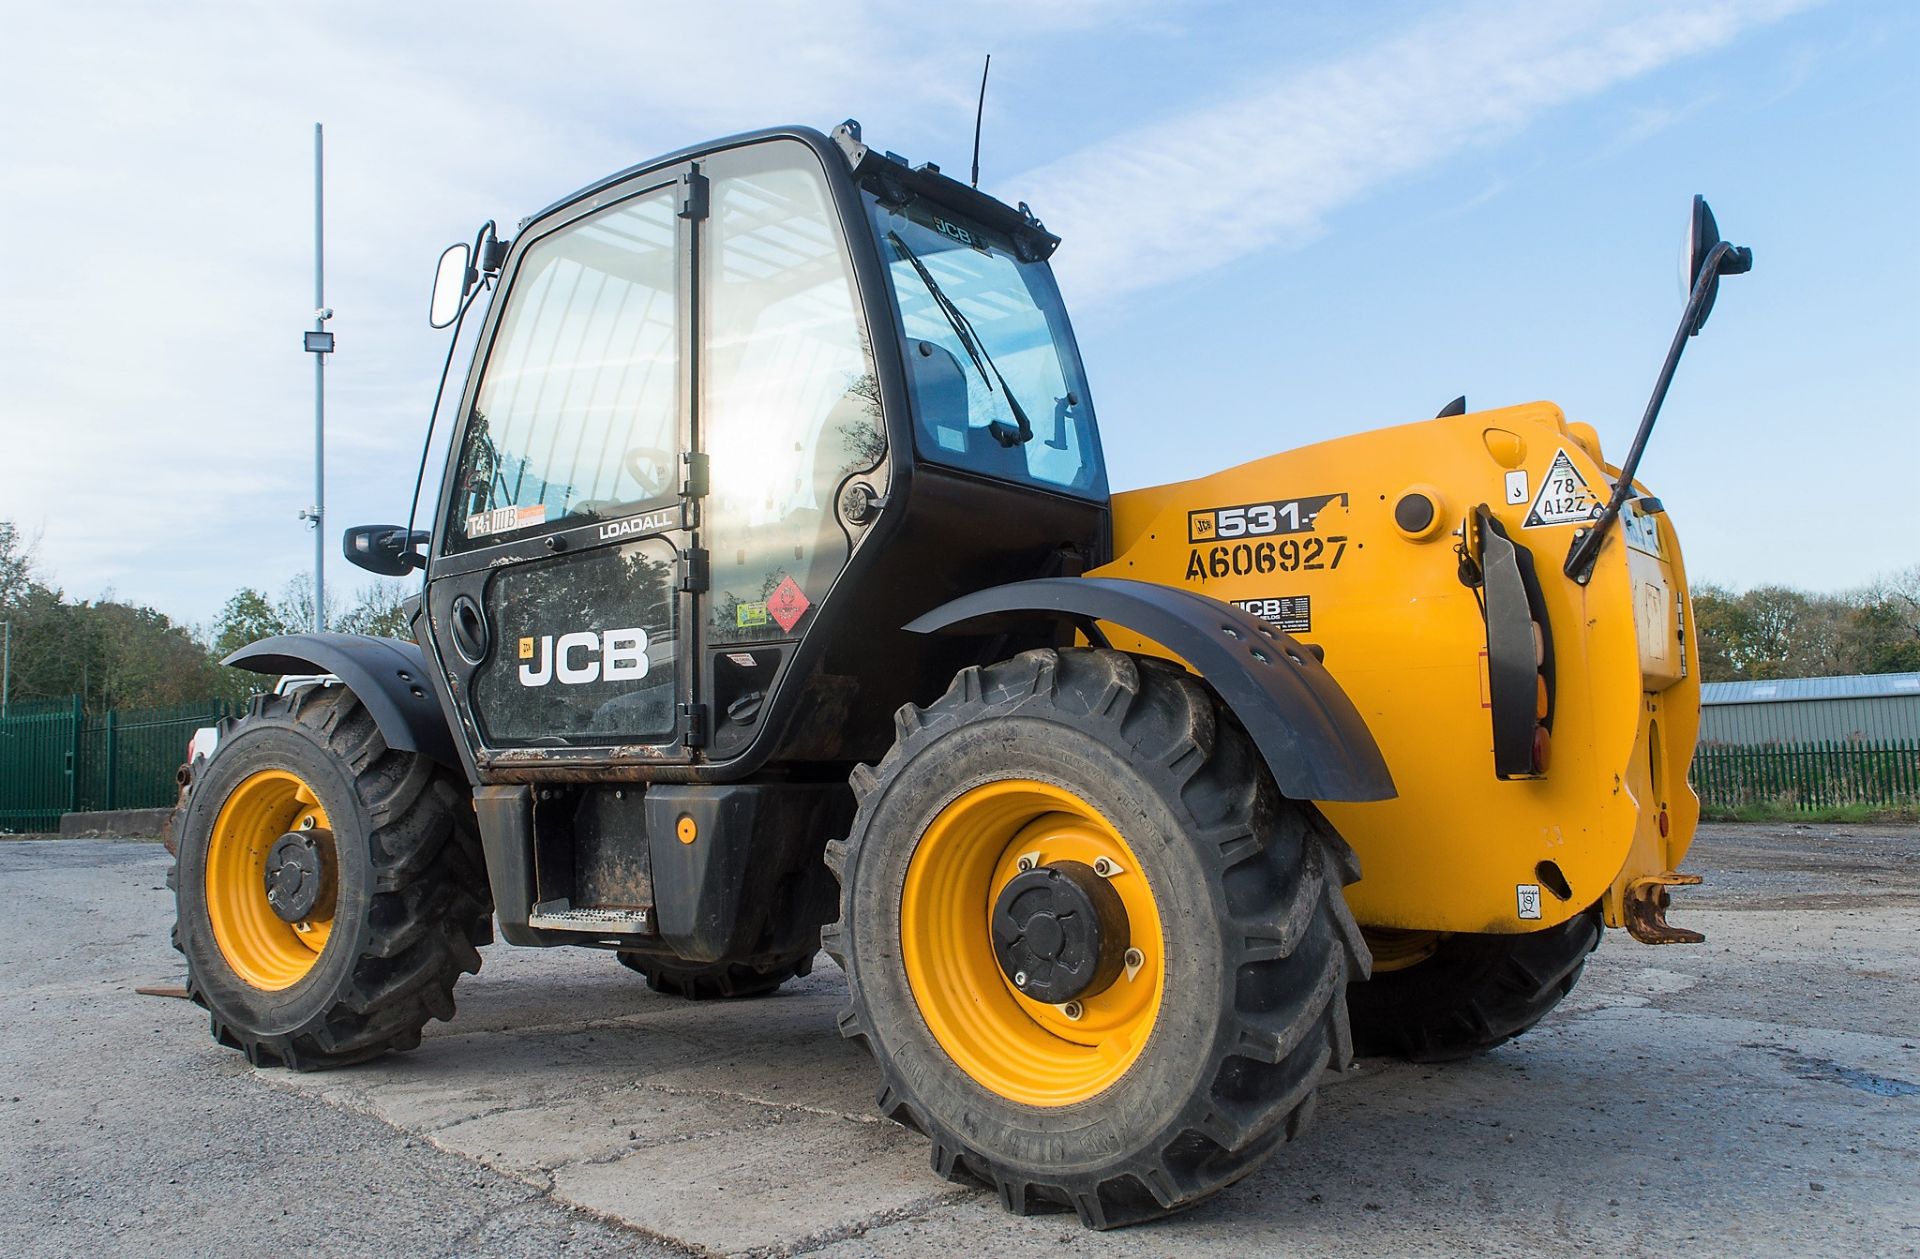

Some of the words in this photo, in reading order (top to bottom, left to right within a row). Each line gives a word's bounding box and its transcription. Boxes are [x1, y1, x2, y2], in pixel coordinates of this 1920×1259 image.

[934, 218, 972, 244] JCB
[1553, 478, 1575, 495] 78
[600, 513, 672, 540] LOADALL
[1185, 536, 1347, 580] A606927
[519, 628, 649, 687] JCB
